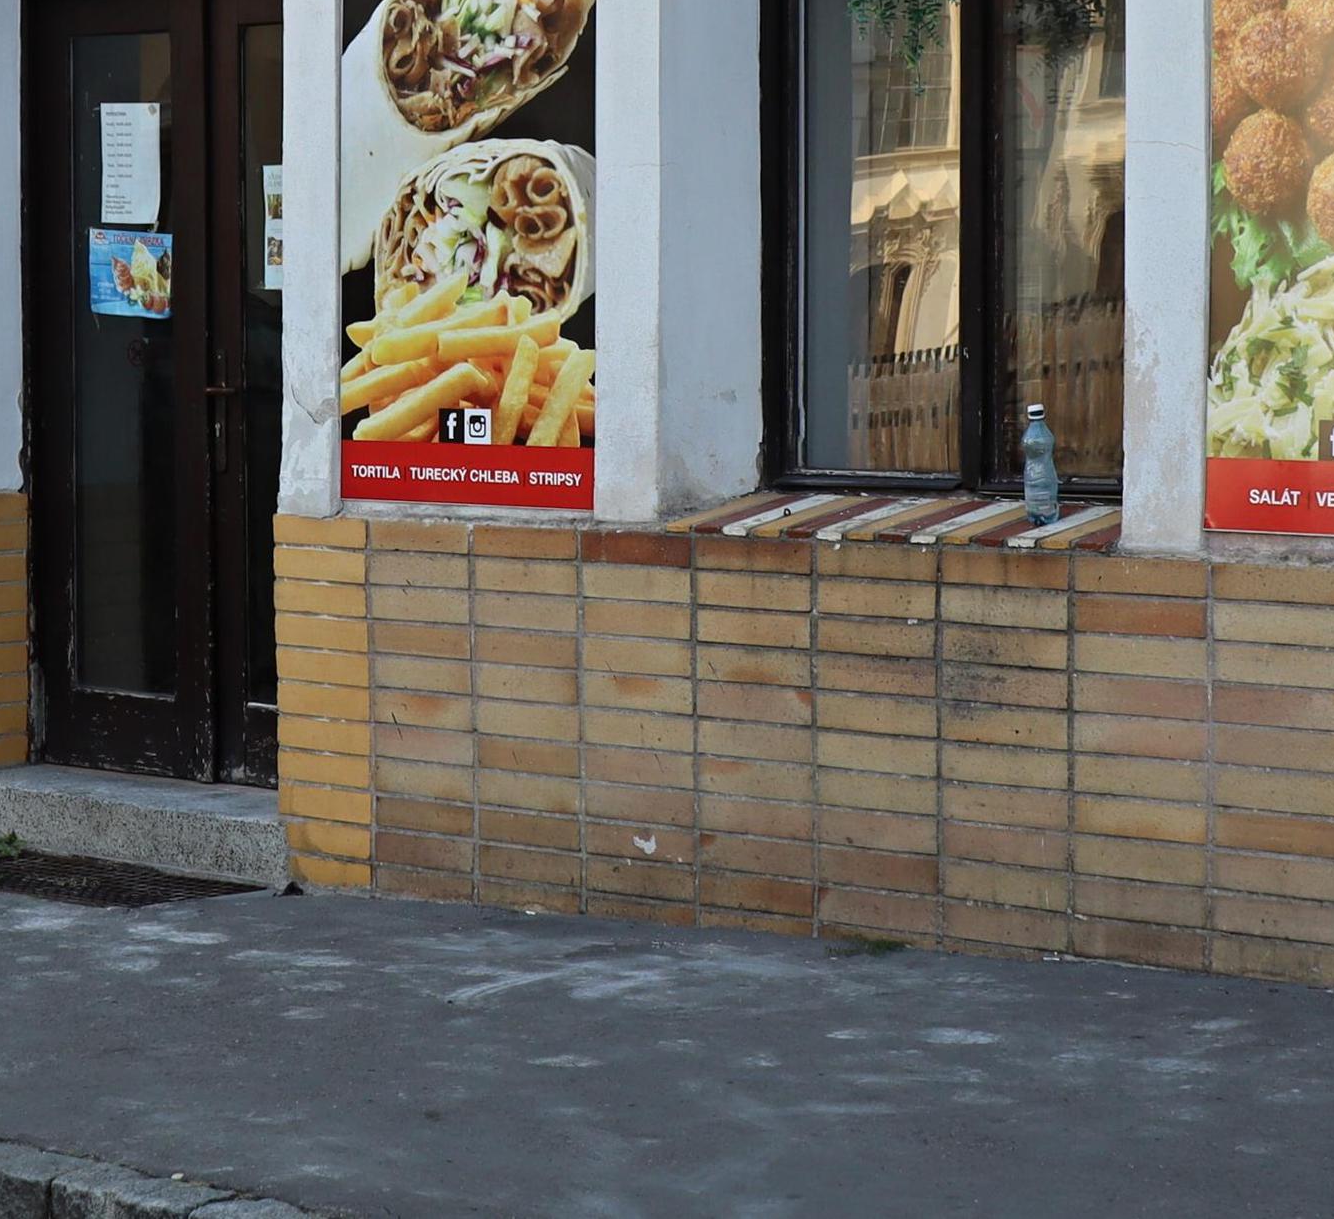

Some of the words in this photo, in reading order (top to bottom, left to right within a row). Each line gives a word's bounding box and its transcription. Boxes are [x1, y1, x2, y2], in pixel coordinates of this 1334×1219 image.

[352, 465, 400, 479] TORTILA
[410, 466, 467, 481] TURECKÝ
[470, 469, 519, 484] CHLEBA
[529, 471, 581, 486] STRIPSY
[1249, 488, 1301, 506] SALÁT
